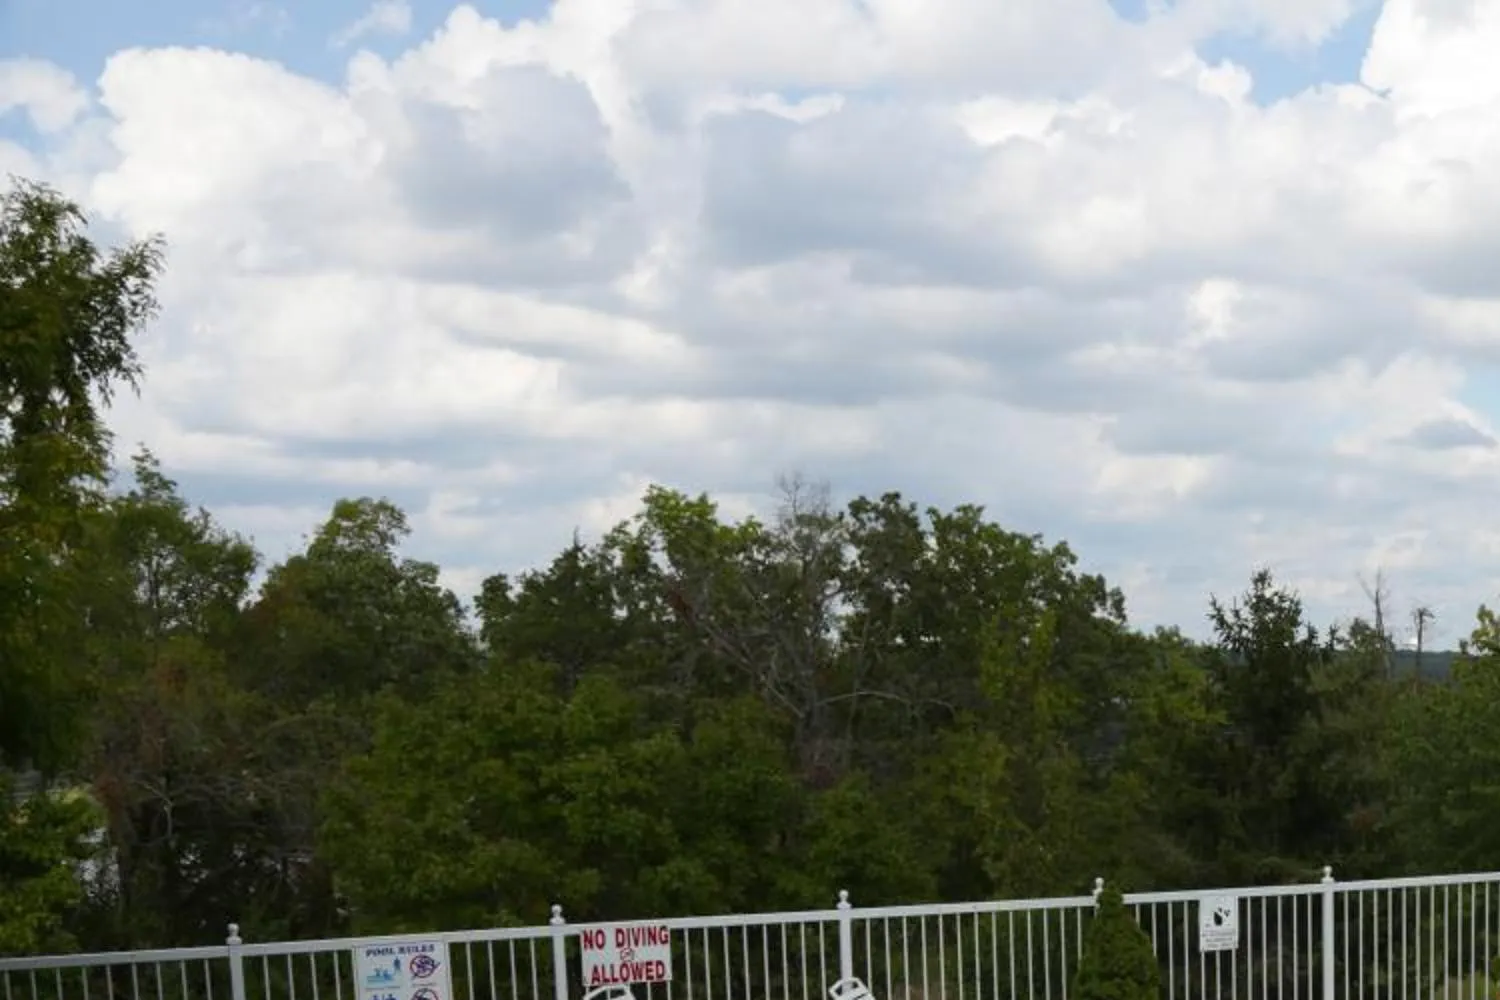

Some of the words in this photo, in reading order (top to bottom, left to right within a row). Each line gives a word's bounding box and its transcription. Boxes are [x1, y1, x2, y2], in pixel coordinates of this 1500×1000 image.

[583, 928, 605, 949] NO
[615, 925, 669, 948] DIVING
[591, 960, 665, 984] ALLOWED
